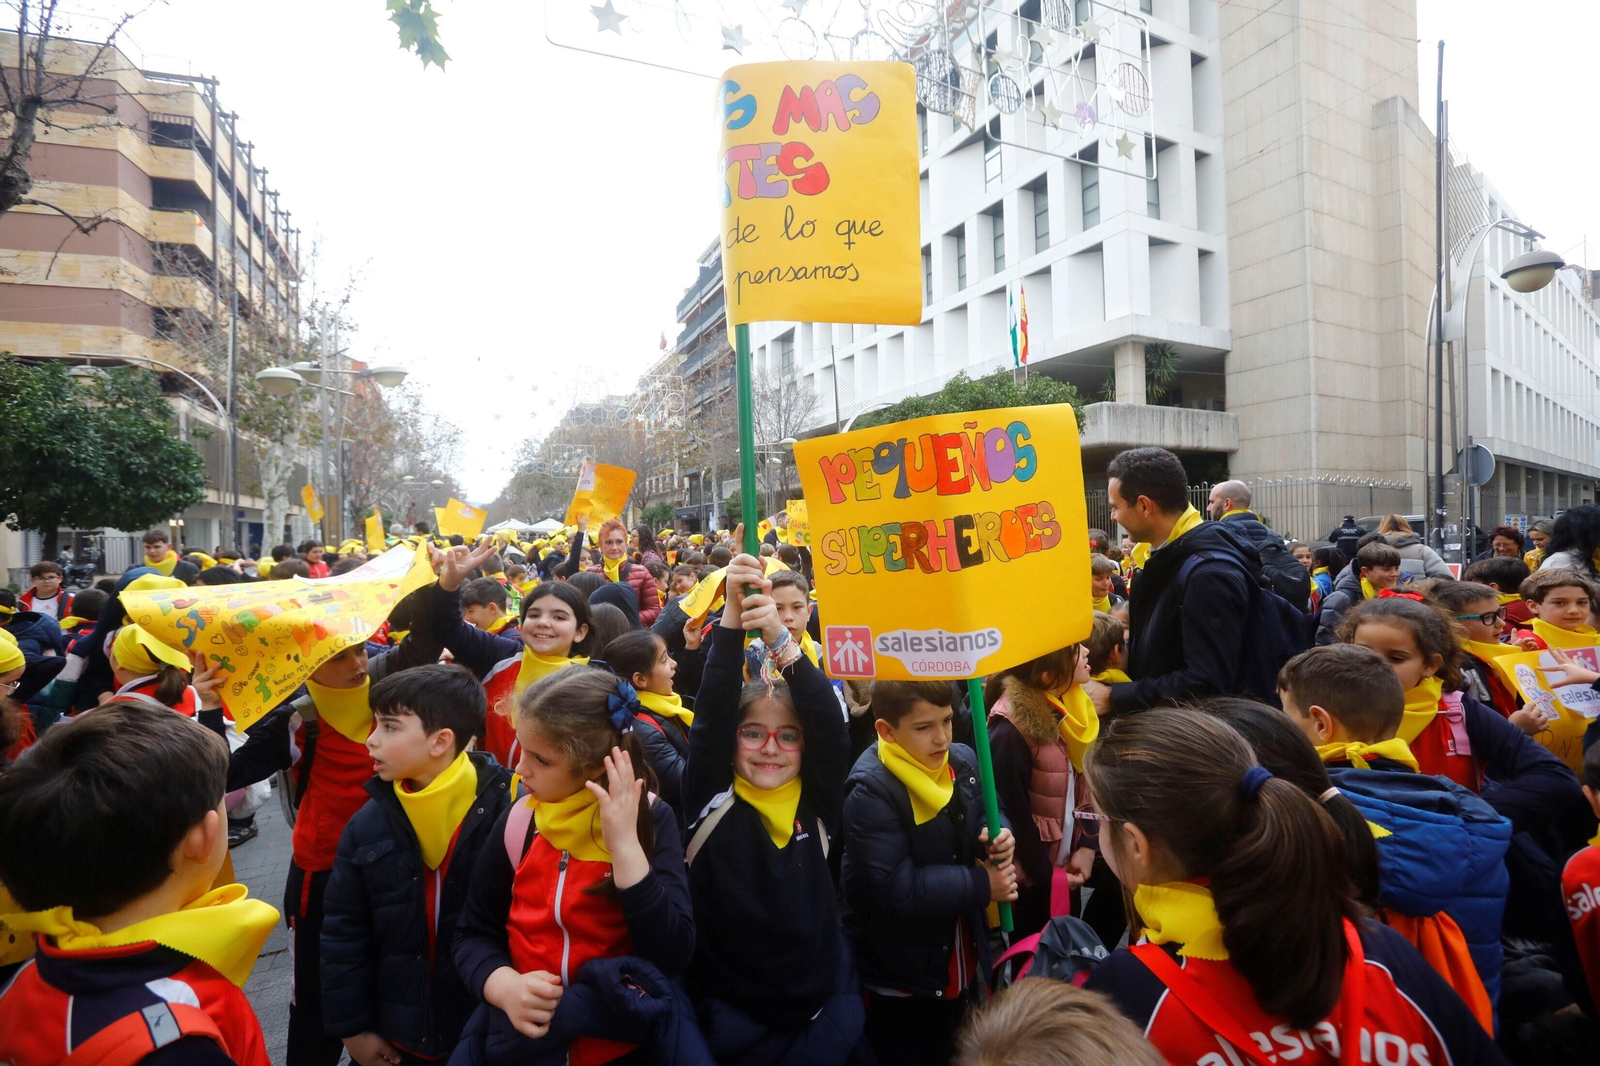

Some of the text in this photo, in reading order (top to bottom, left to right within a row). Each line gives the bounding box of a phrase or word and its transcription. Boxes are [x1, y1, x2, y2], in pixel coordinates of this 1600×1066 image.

[772, 74, 881, 136] MAS
[721, 141, 831, 208] TES
[726, 205, 884, 250] de lo que
[733, 263, 860, 305] pensamos
[821, 501, 1062, 576] SUPERHEROES
[878, 628, 999, 654] salesianos
[911, 656, 971, 673] CÓRDOBA
